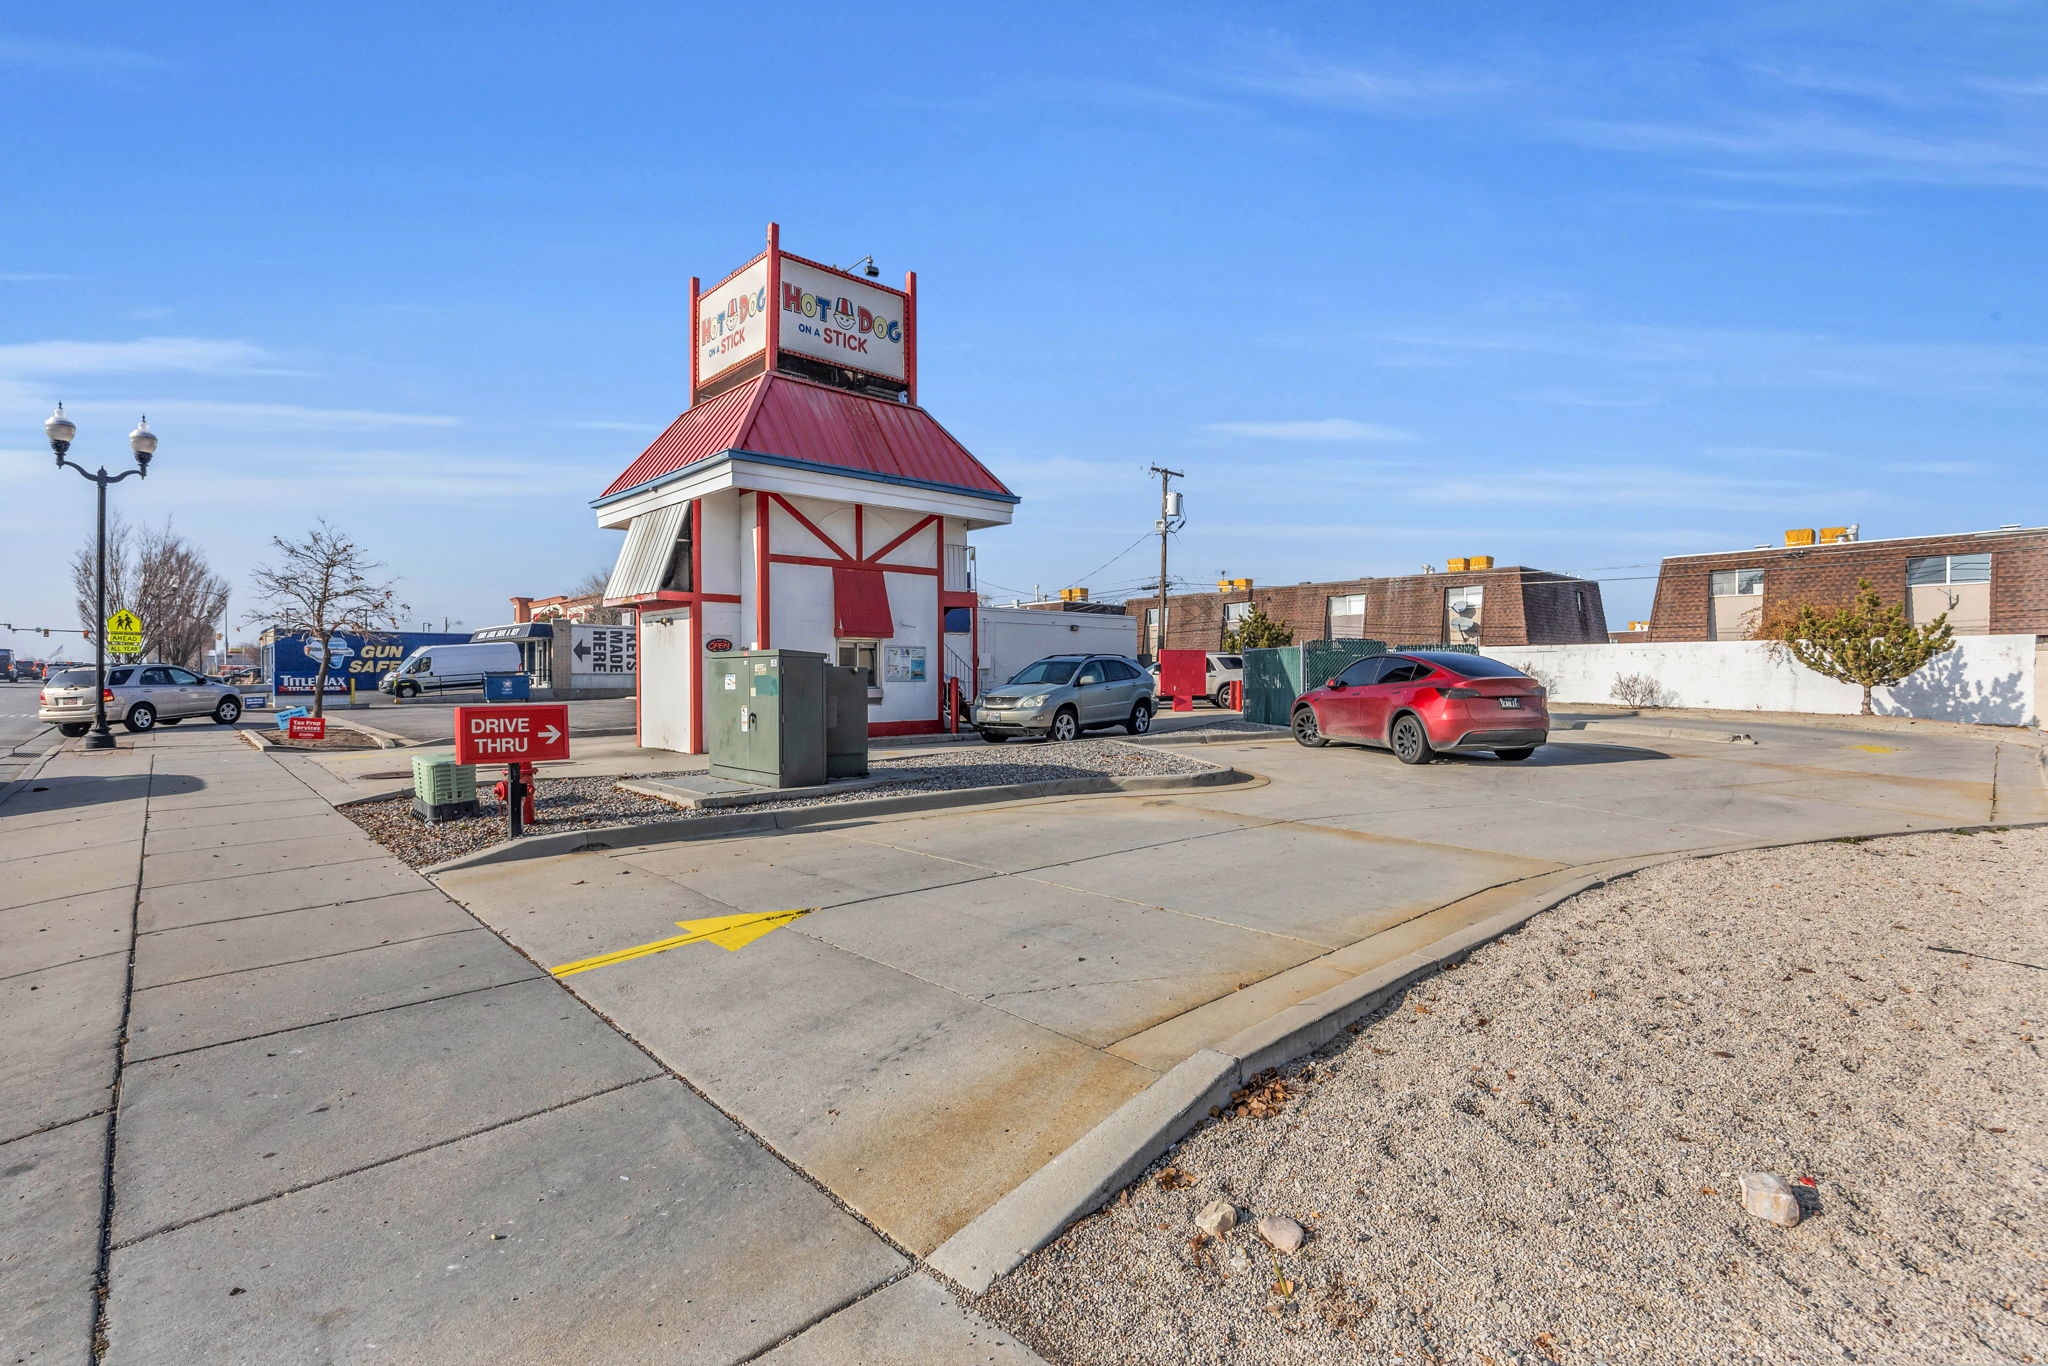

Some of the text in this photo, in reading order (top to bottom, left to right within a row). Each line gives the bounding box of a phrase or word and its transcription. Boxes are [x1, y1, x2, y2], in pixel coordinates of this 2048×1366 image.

[702, 286, 765, 346] HOT DOG
[782, 281, 901, 343] HOT DOG
[721, 327, 745, 354] STICK
[798, 323, 868, 354] ON A STICK
[360, 645, 404, 658] GUN
[593, 631, 606, 672] HERE
[610, 631, 623, 672] MADE
[626, 633, 636, 671] KEYS
[708, 642, 730, 650] OPEN
[348, 660, 402, 673] SAFE
[471, 718, 530, 734] DRIVE
[474, 738, 528, 753] THRU
